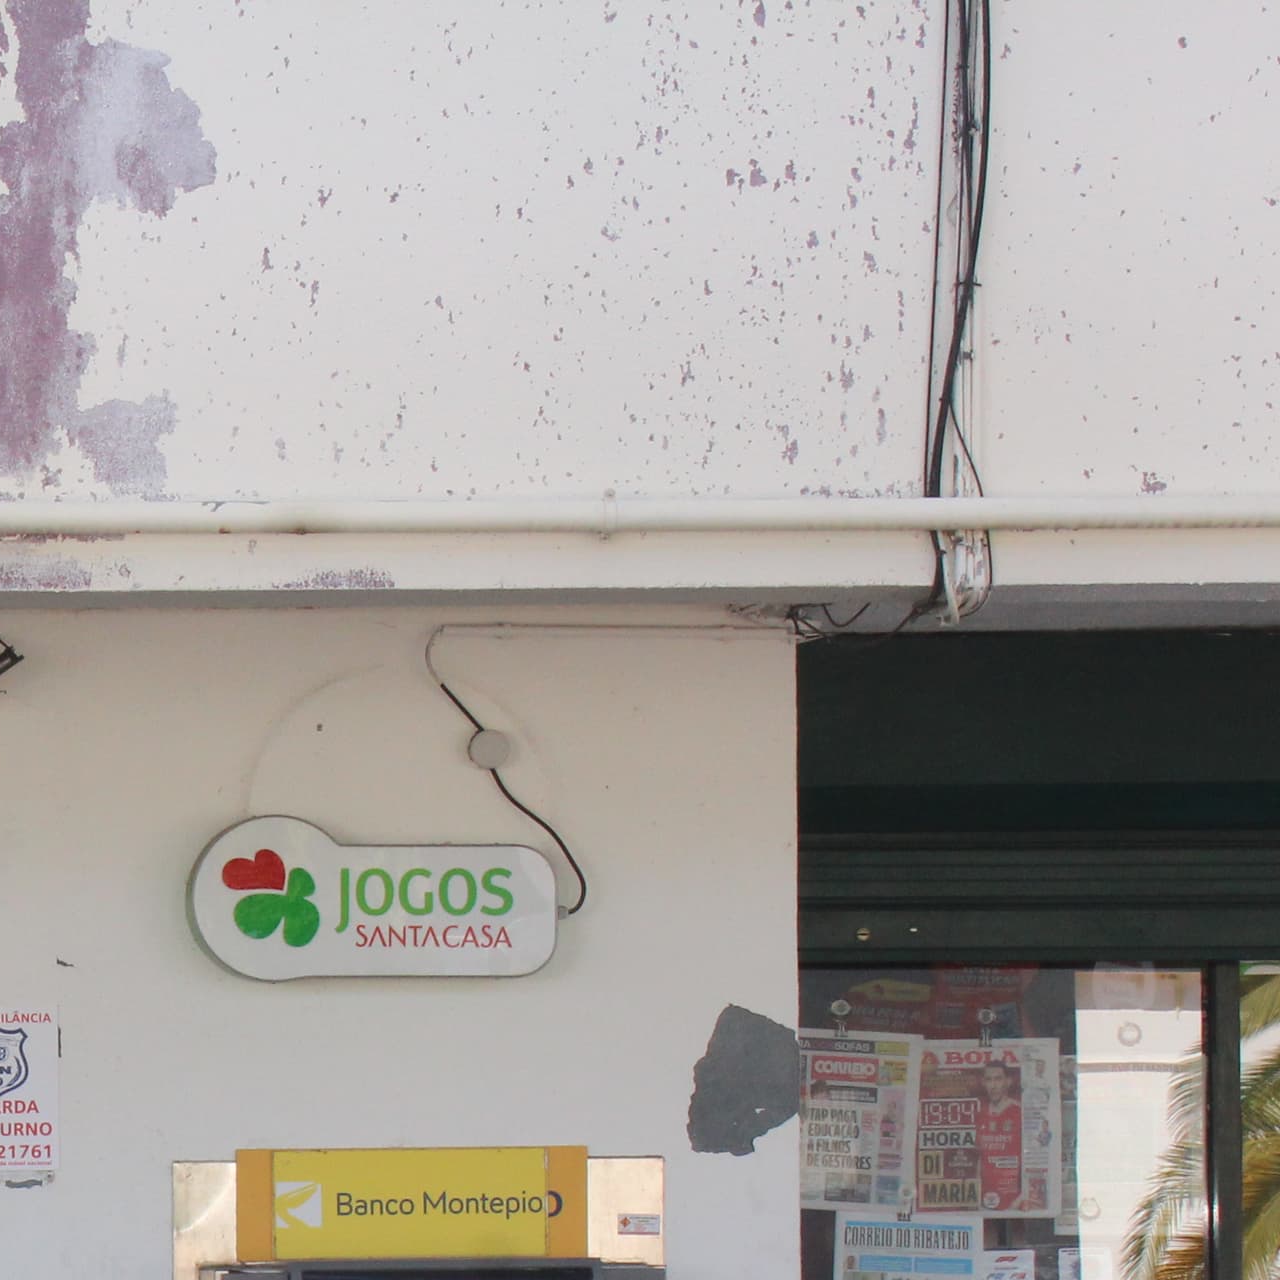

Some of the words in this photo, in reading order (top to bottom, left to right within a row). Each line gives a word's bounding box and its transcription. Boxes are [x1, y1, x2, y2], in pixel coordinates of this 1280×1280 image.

[335, 867, 515, 933] JOGOS
[355, 924, 512, 949] SANTACASA
[944, 1050, 1019, 1065] BOLA
[923, 1131, 975, 1147] HORA
[923, 1154, 940, 1175] DI
[335, 1191, 415, 1216] Banco
[422, 1189, 545, 1222] Montepio
[844, 1225, 893, 1247] CORREIO
[896, 1228, 911, 1248] DO
[914, 1229, 969, 1250] RIBATEJO
